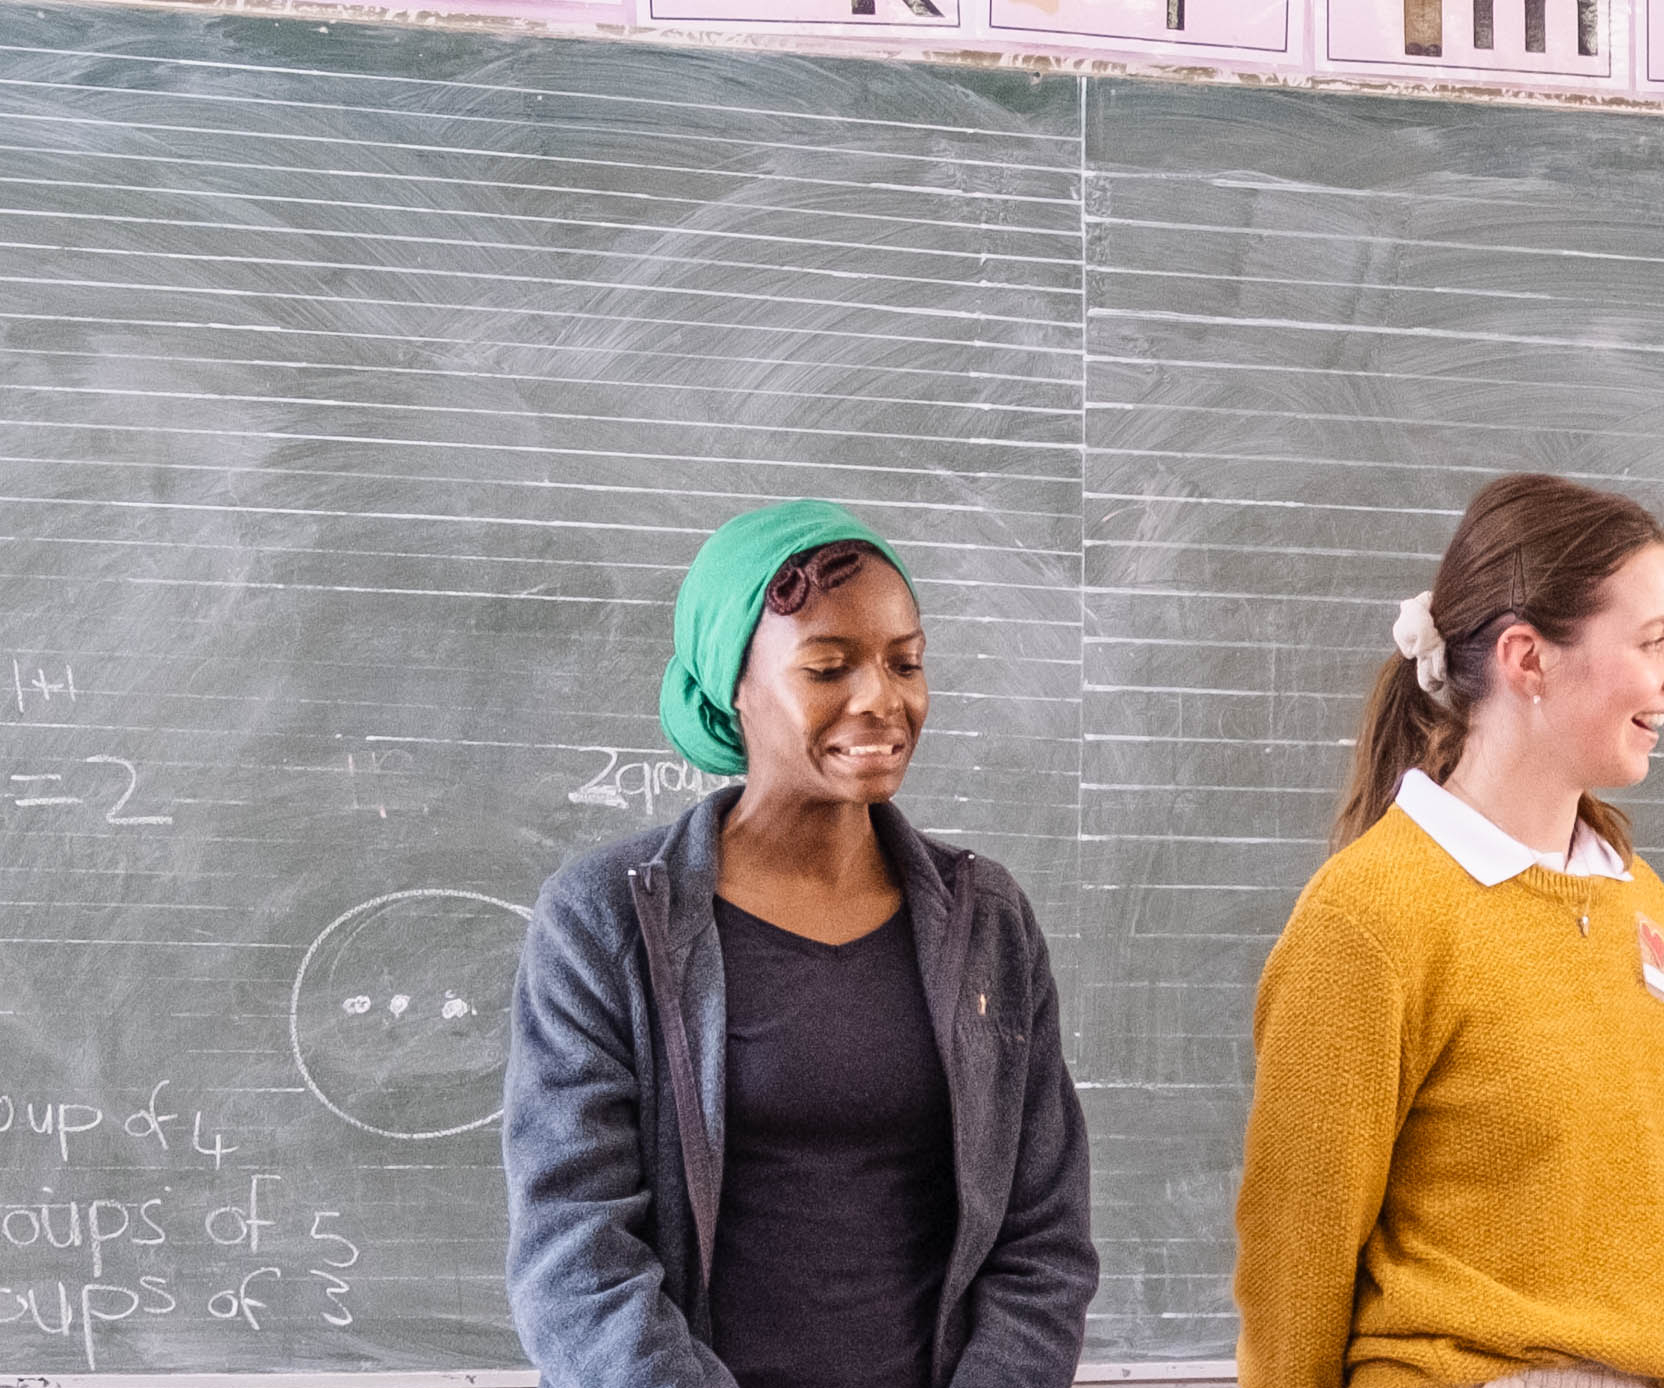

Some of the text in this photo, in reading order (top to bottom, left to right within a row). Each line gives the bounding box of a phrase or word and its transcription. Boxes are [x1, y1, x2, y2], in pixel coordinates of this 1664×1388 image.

[125, 1080, 178, 1150] of
[194, 1110, 239, 1170] 4
[206, 1174, 281, 1253] of
[310, 1211, 359, 1268] 5
[208, 1267, 281, 1330] of
[310, 1268, 353, 1326] 3
